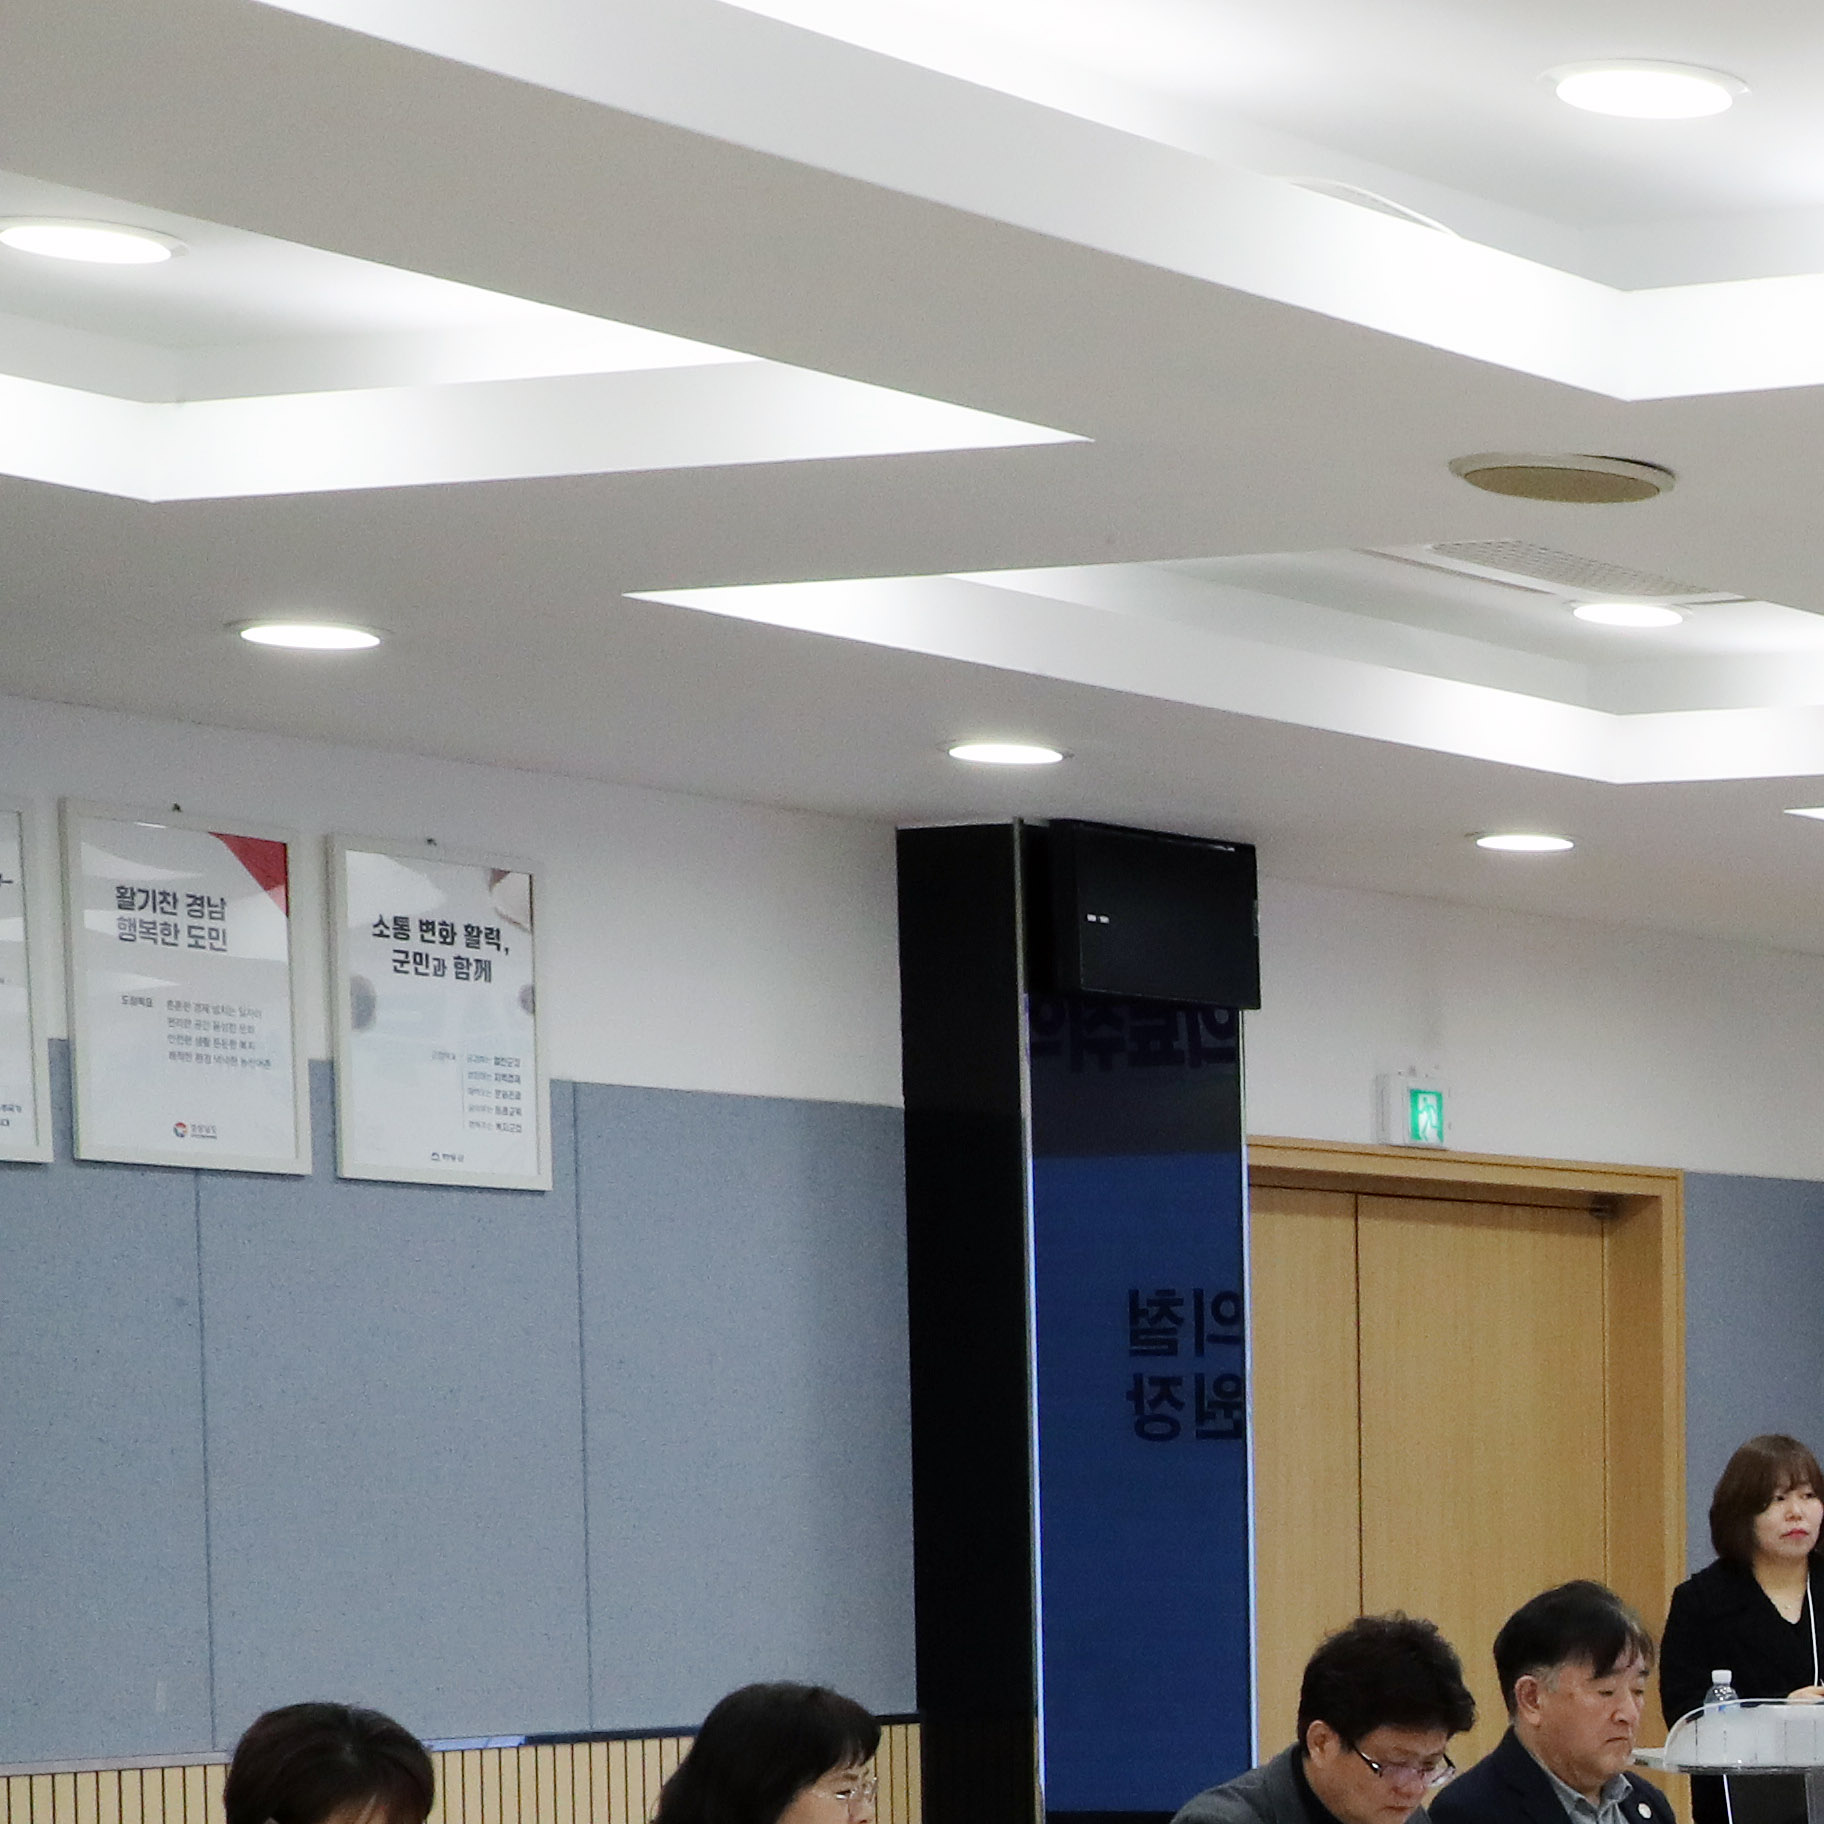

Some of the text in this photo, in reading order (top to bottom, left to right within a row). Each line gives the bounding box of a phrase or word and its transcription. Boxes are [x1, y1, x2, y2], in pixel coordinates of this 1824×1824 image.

[115, 885, 227, 921] 활기찬 경남
[116, 916, 228, 952] 행복한 도민
[372, 914, 411, 942] 소통
[419, 919, 457, 946] 변화
[392, 949, 492, 983] 군민과 함께
